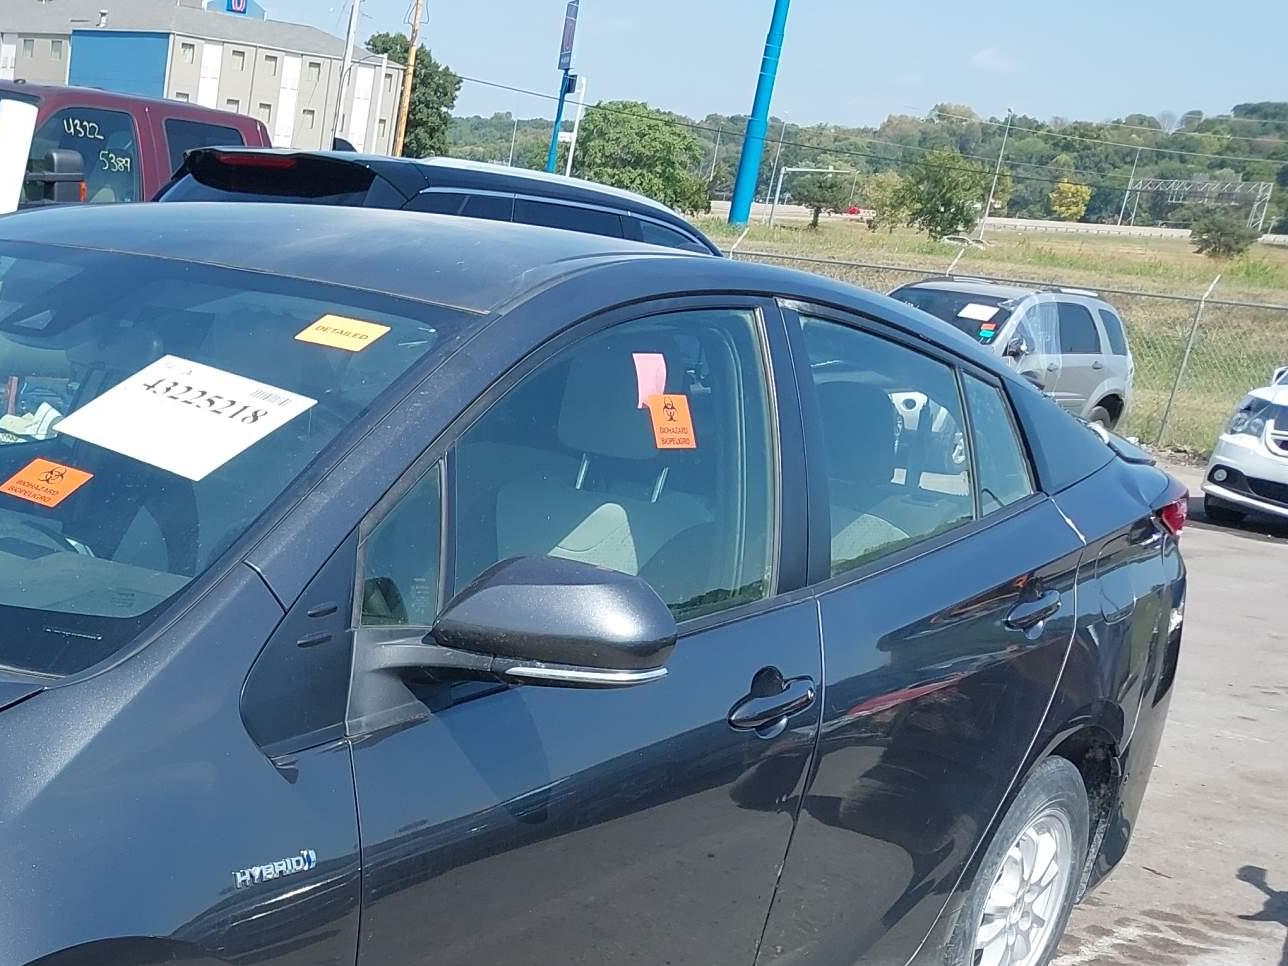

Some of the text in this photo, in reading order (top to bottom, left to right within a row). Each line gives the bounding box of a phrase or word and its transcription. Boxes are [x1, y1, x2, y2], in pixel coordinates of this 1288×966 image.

[63, 117, 105, 139] 4322
[99, 150, 131, 173] 5389
[315, 325, 369, 340] DETAILED
[143, 378, 268, 424] 43225218
[659, 426, 689, 435] BIOHAZARD
[7, 486, 52, 503] BIOPELIGRO
[16, 479, 59, 496] BIOHAZARD
[232, 855, 305, 888] HYBRID
